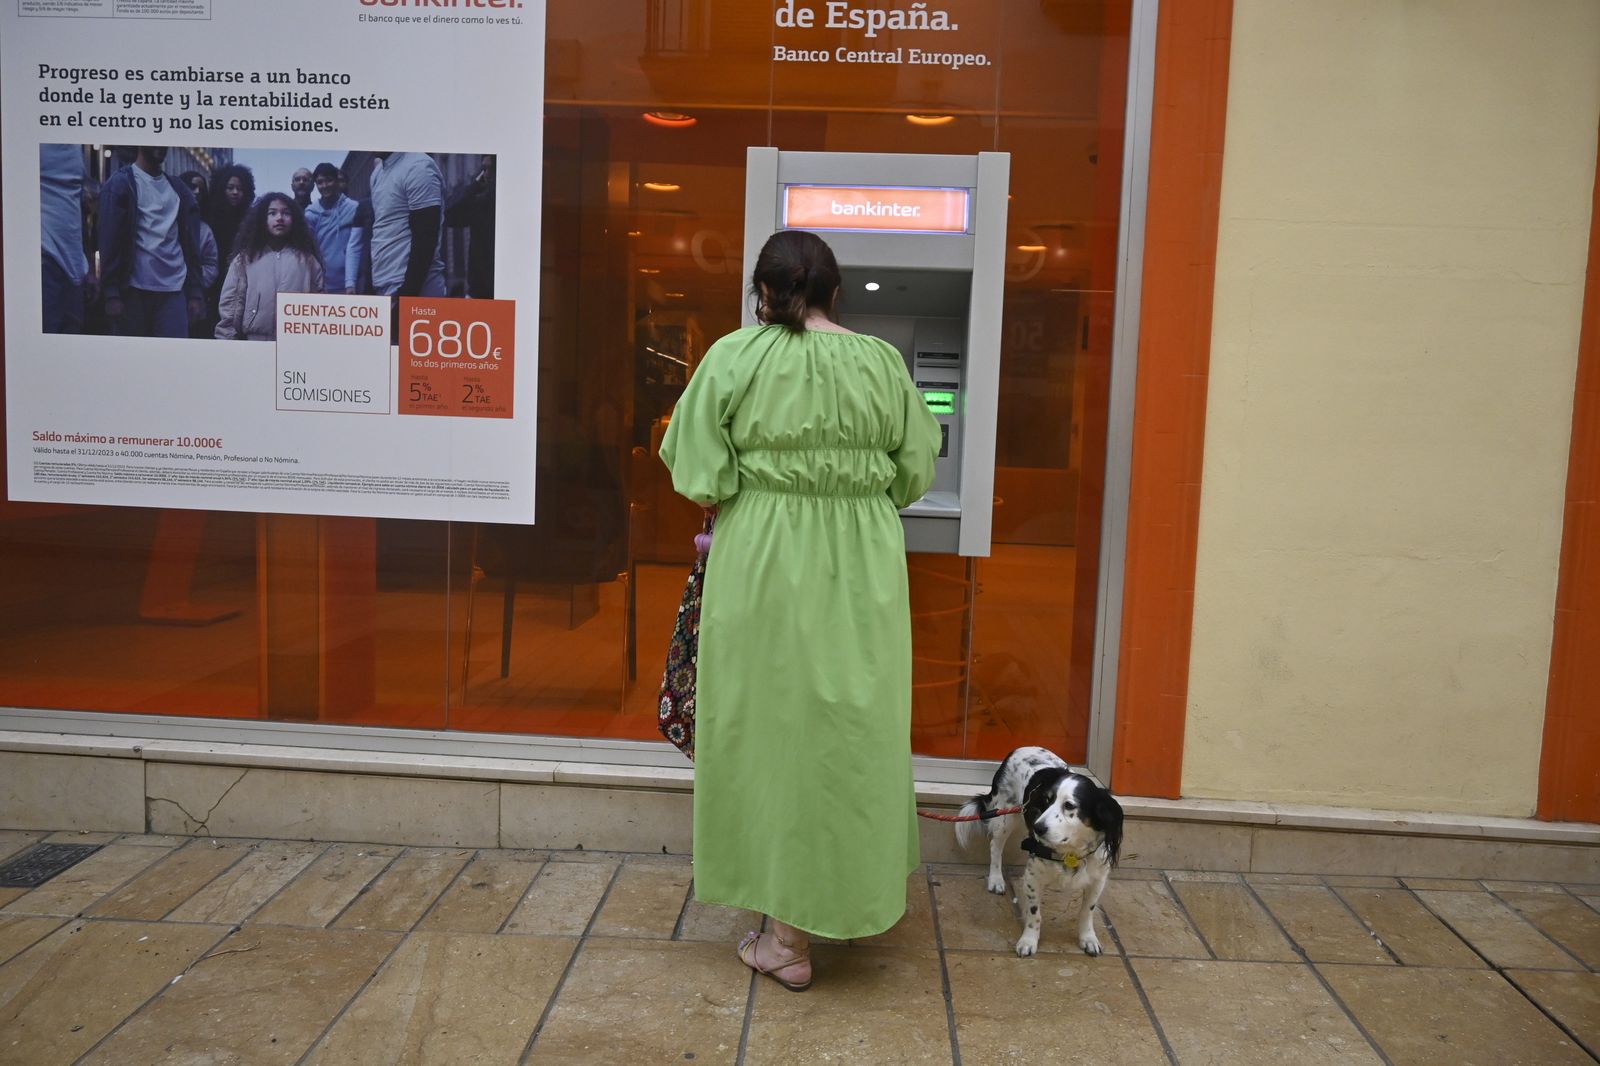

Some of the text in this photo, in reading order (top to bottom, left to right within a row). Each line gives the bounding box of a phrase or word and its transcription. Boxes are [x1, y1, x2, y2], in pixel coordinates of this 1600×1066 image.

[358, 13, 366, 22] El
[368, 13, 393, 22] banco
[394, 16, 410, 24] que
[423, 14, 430, 23] el
[432, 15, 459, 23] dinero
[486, 15, 493, 24] lo
[511, 16, 523, 24] tú.
[775, 0, 958, 37] de España.
[772, 45, 991, 70] Banco Central Europeo.
[38, 63, 350, 84] Progreso es cambiarse a un banco
[39, 86, 389, 110] donde la gente y la rentabilidad estén
[39, 112, 338, 133] en el centro y no las comisiones.
[831, 200, 921, 217] bankinter.
[283, 303, 378, 318] CUENTAS CON
[411, 306, 437, 316] Hasta
[284, 321, 383, 336] RENTABILIDAD
[410, 359, 498, 370] los dos primeros años
[283, 370, 305, 384] SIN
[283, 386, 371, 403] COMISIONES
[32, 430, 222, 448] Saldo máximo a remunerar 10.000€
[33, 446, 52, 455] Válido
[77, 448, 114, 456] 31/12/2023
[169, 452, 194, 460] Nómina,
[196, 453, 222, 461] Pensión,
[223, 454, 258, 462] Profesional
